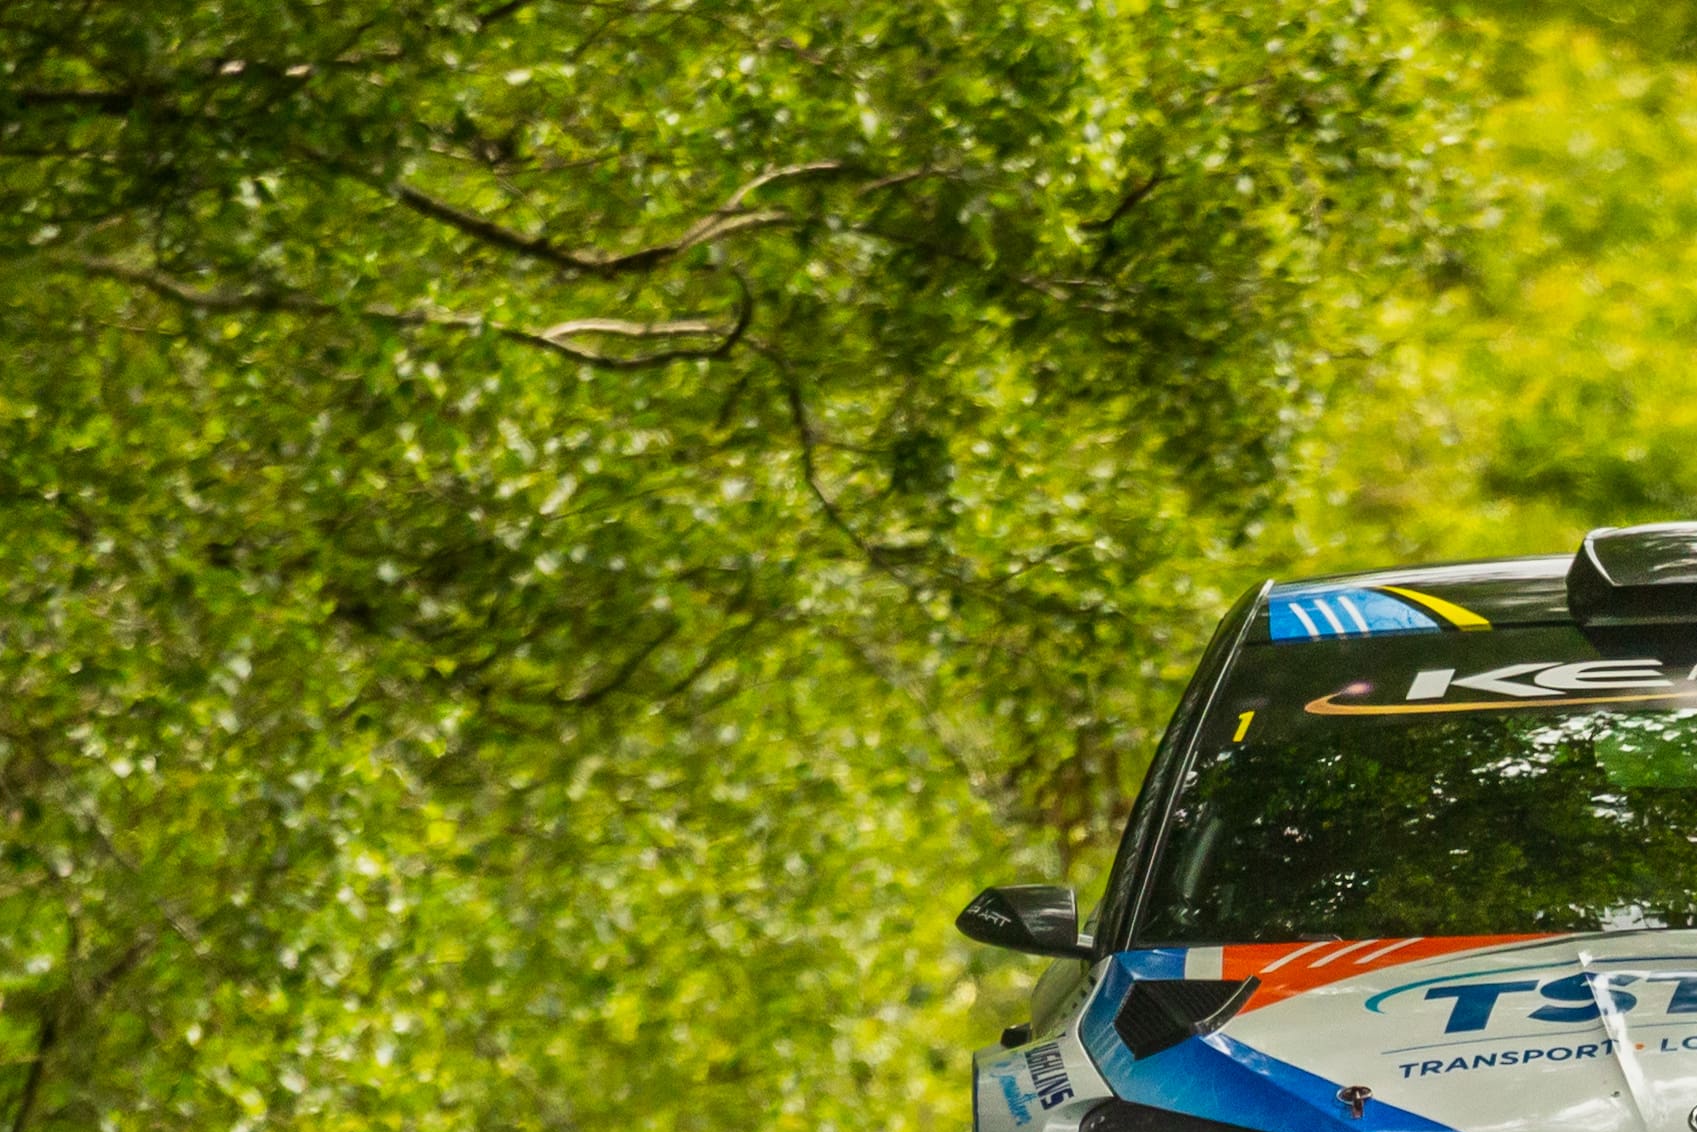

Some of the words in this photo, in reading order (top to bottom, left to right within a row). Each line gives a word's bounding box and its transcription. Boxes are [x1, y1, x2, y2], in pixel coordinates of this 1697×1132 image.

[1406, 659, 1674, 700] KE
[1233, 710, 1255, 742] 1
[1399, 1038, 1619, 1079] TRANSPORT
